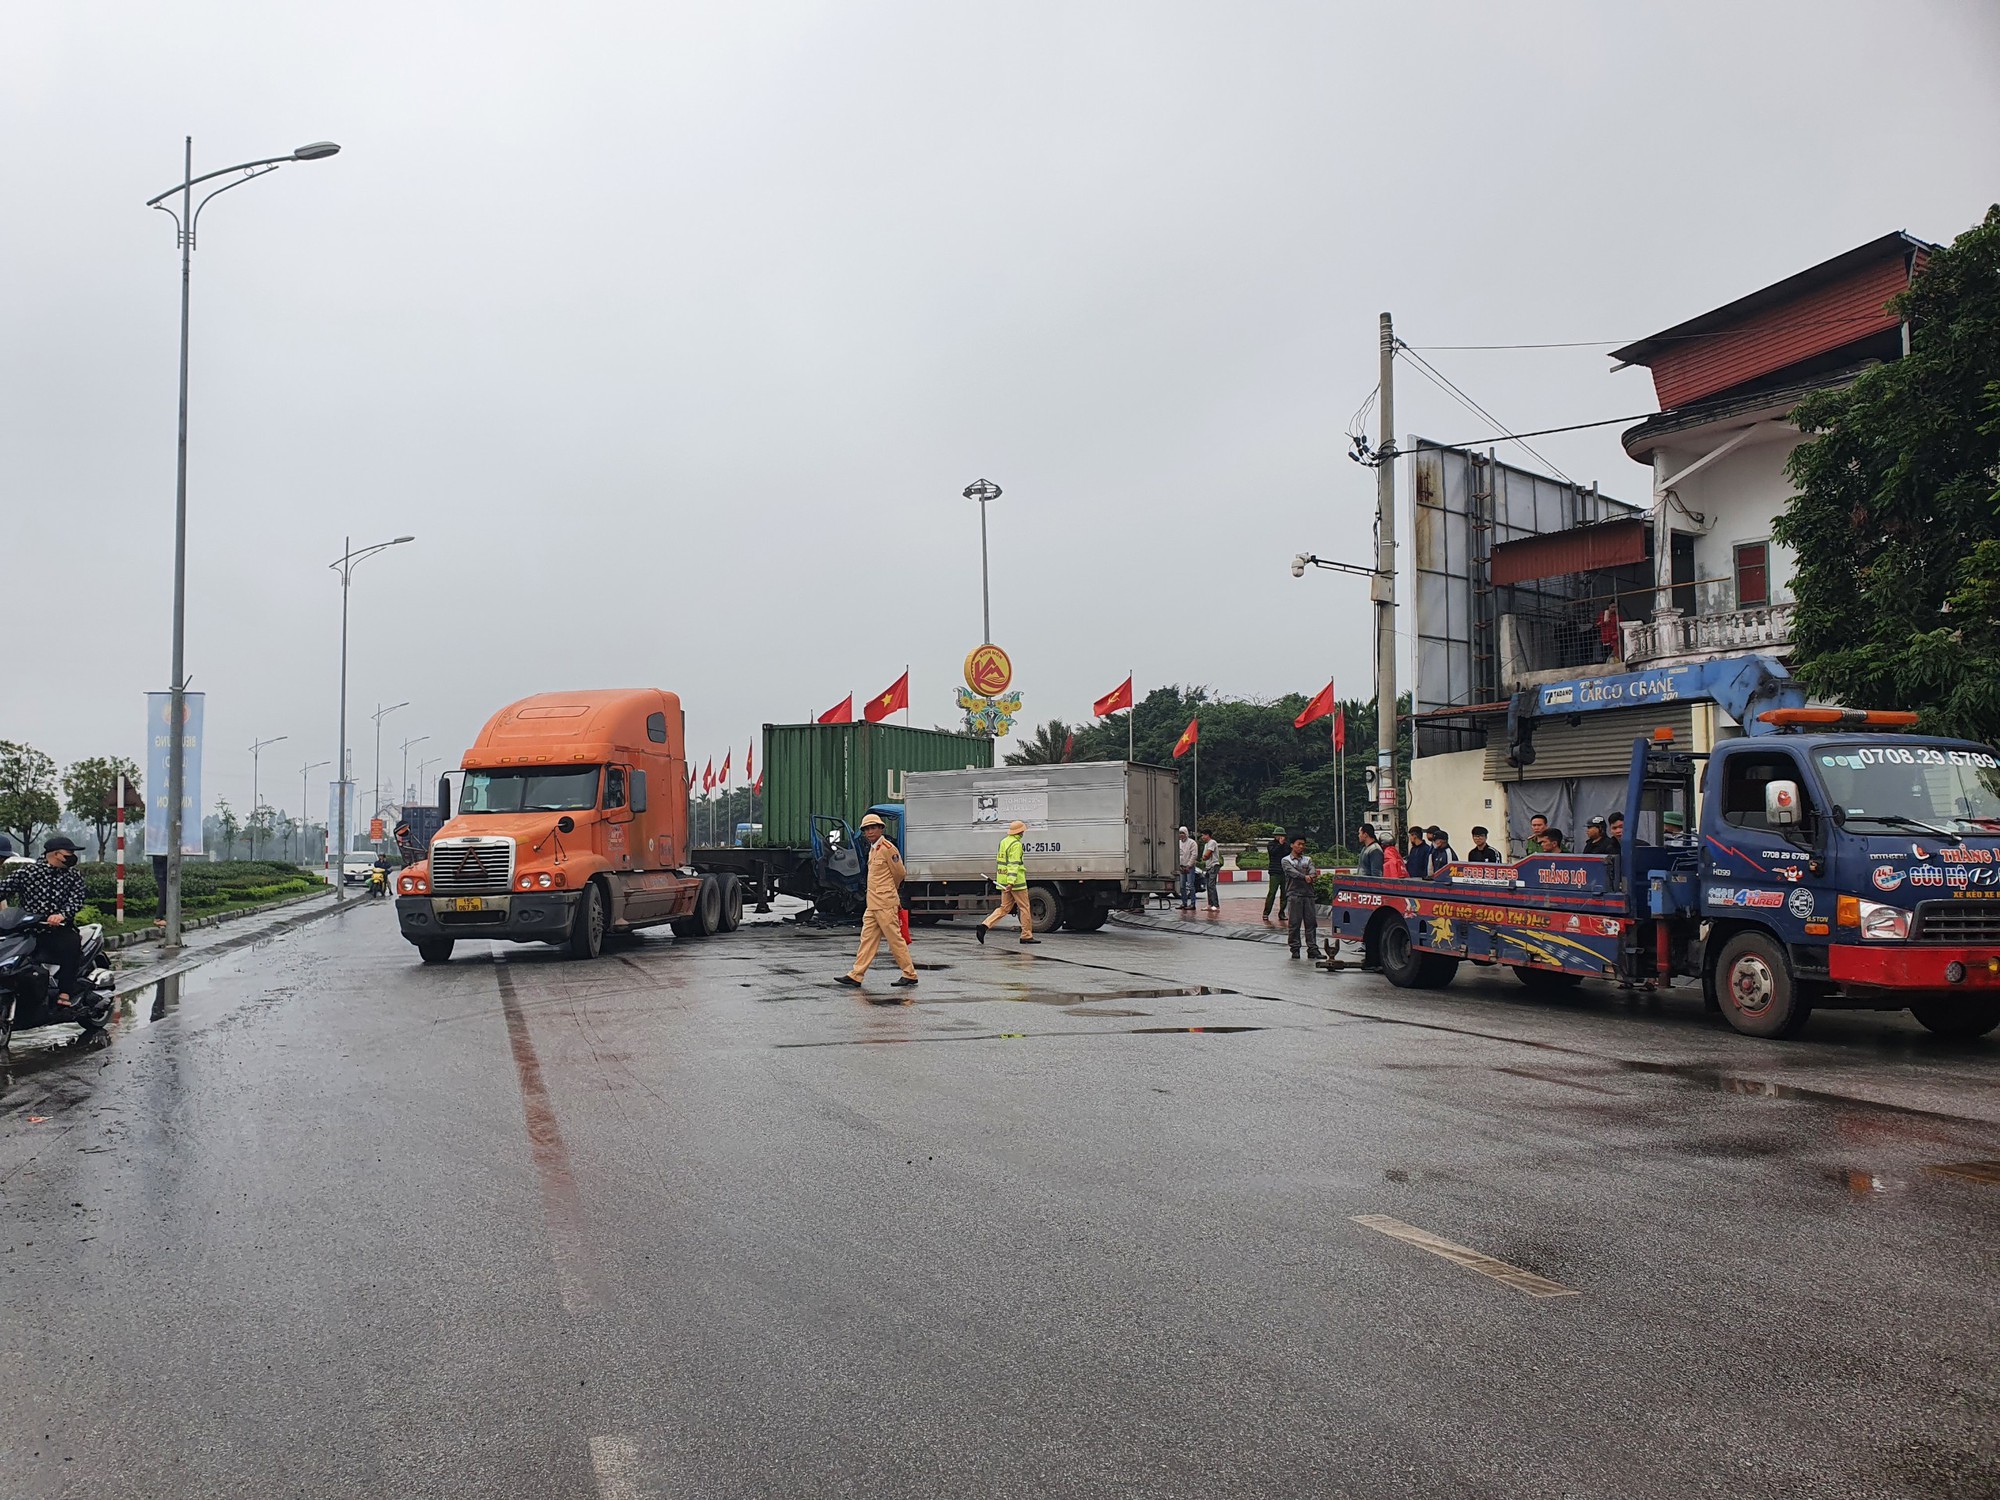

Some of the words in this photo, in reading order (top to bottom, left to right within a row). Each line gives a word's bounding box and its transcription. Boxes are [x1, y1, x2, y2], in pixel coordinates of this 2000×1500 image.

[1580, 684, 1623, 703] CARGO
[1629, 677, 1675, 697] CRANE
[1762, 851, 1780, 859] 0708
[1781, 851, 1790, 859] 29
[1791, 852, 1810, 860] 6789
[1338, 892, 1352, 902] 34H
[1432, 901, 1453, 916] CỨU
[1475, 908, 1505, 922] GIAO
